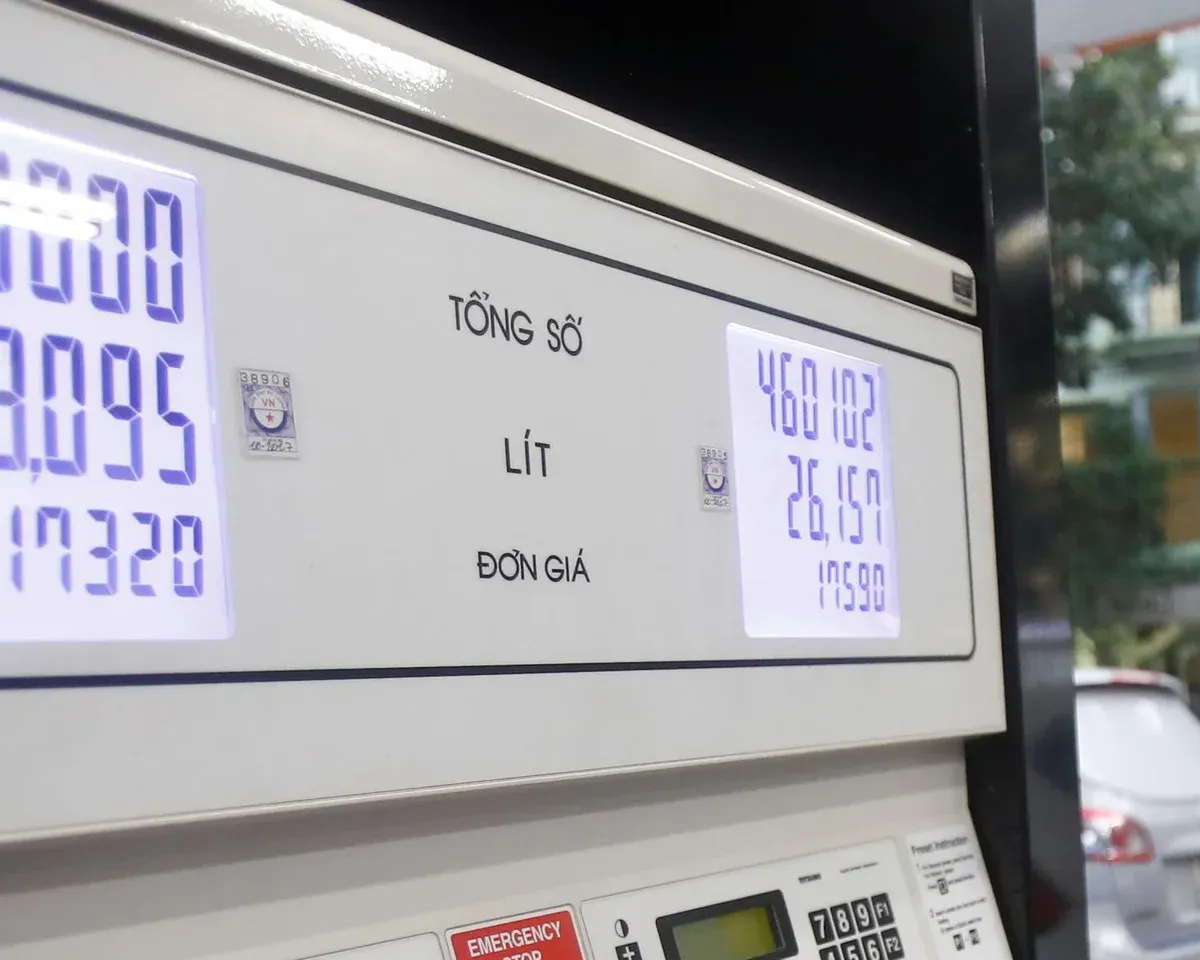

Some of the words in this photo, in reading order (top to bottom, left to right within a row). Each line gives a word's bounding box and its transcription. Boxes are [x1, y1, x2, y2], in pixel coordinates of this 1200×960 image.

[0, 151, 185, 325] 000
[448, 290, 535, 346] TỔNG
[546, 313, 583, 357] SỐ
[757, 348, 876, 452] 460102
[504, 428, 551, 478] LÍT
[787, 454, 883, 547] 26,157
[11, 504, 204, 598] 17320
[544, 547, 591, 583] GIÁ
[819, 559, 886, 612] 17590
[467, 920, 562, 958] EMERGENCY
[814, 914, 826, 939] 7
[836, 909, 850, 933] 8
[856, 903, 870, 927] 9
[876, 902, 890, 920] F1
[886, 937, 901, 954] F2
